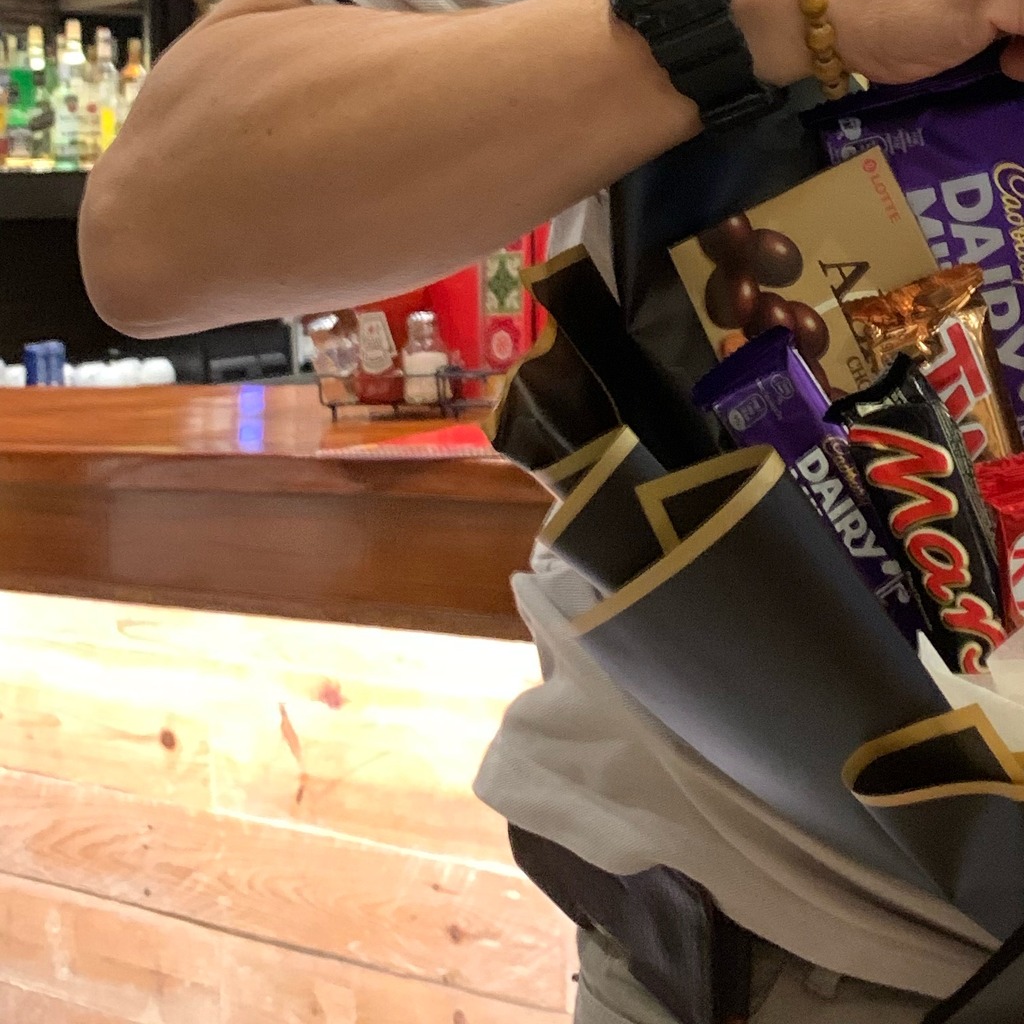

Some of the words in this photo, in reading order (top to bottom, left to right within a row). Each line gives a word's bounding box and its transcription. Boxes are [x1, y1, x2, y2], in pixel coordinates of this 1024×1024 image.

[871, 174, 900, 225] LOTTE
[796, 446, 887, 559] DAIRY
[848, 425, 1007, 675] Mars
